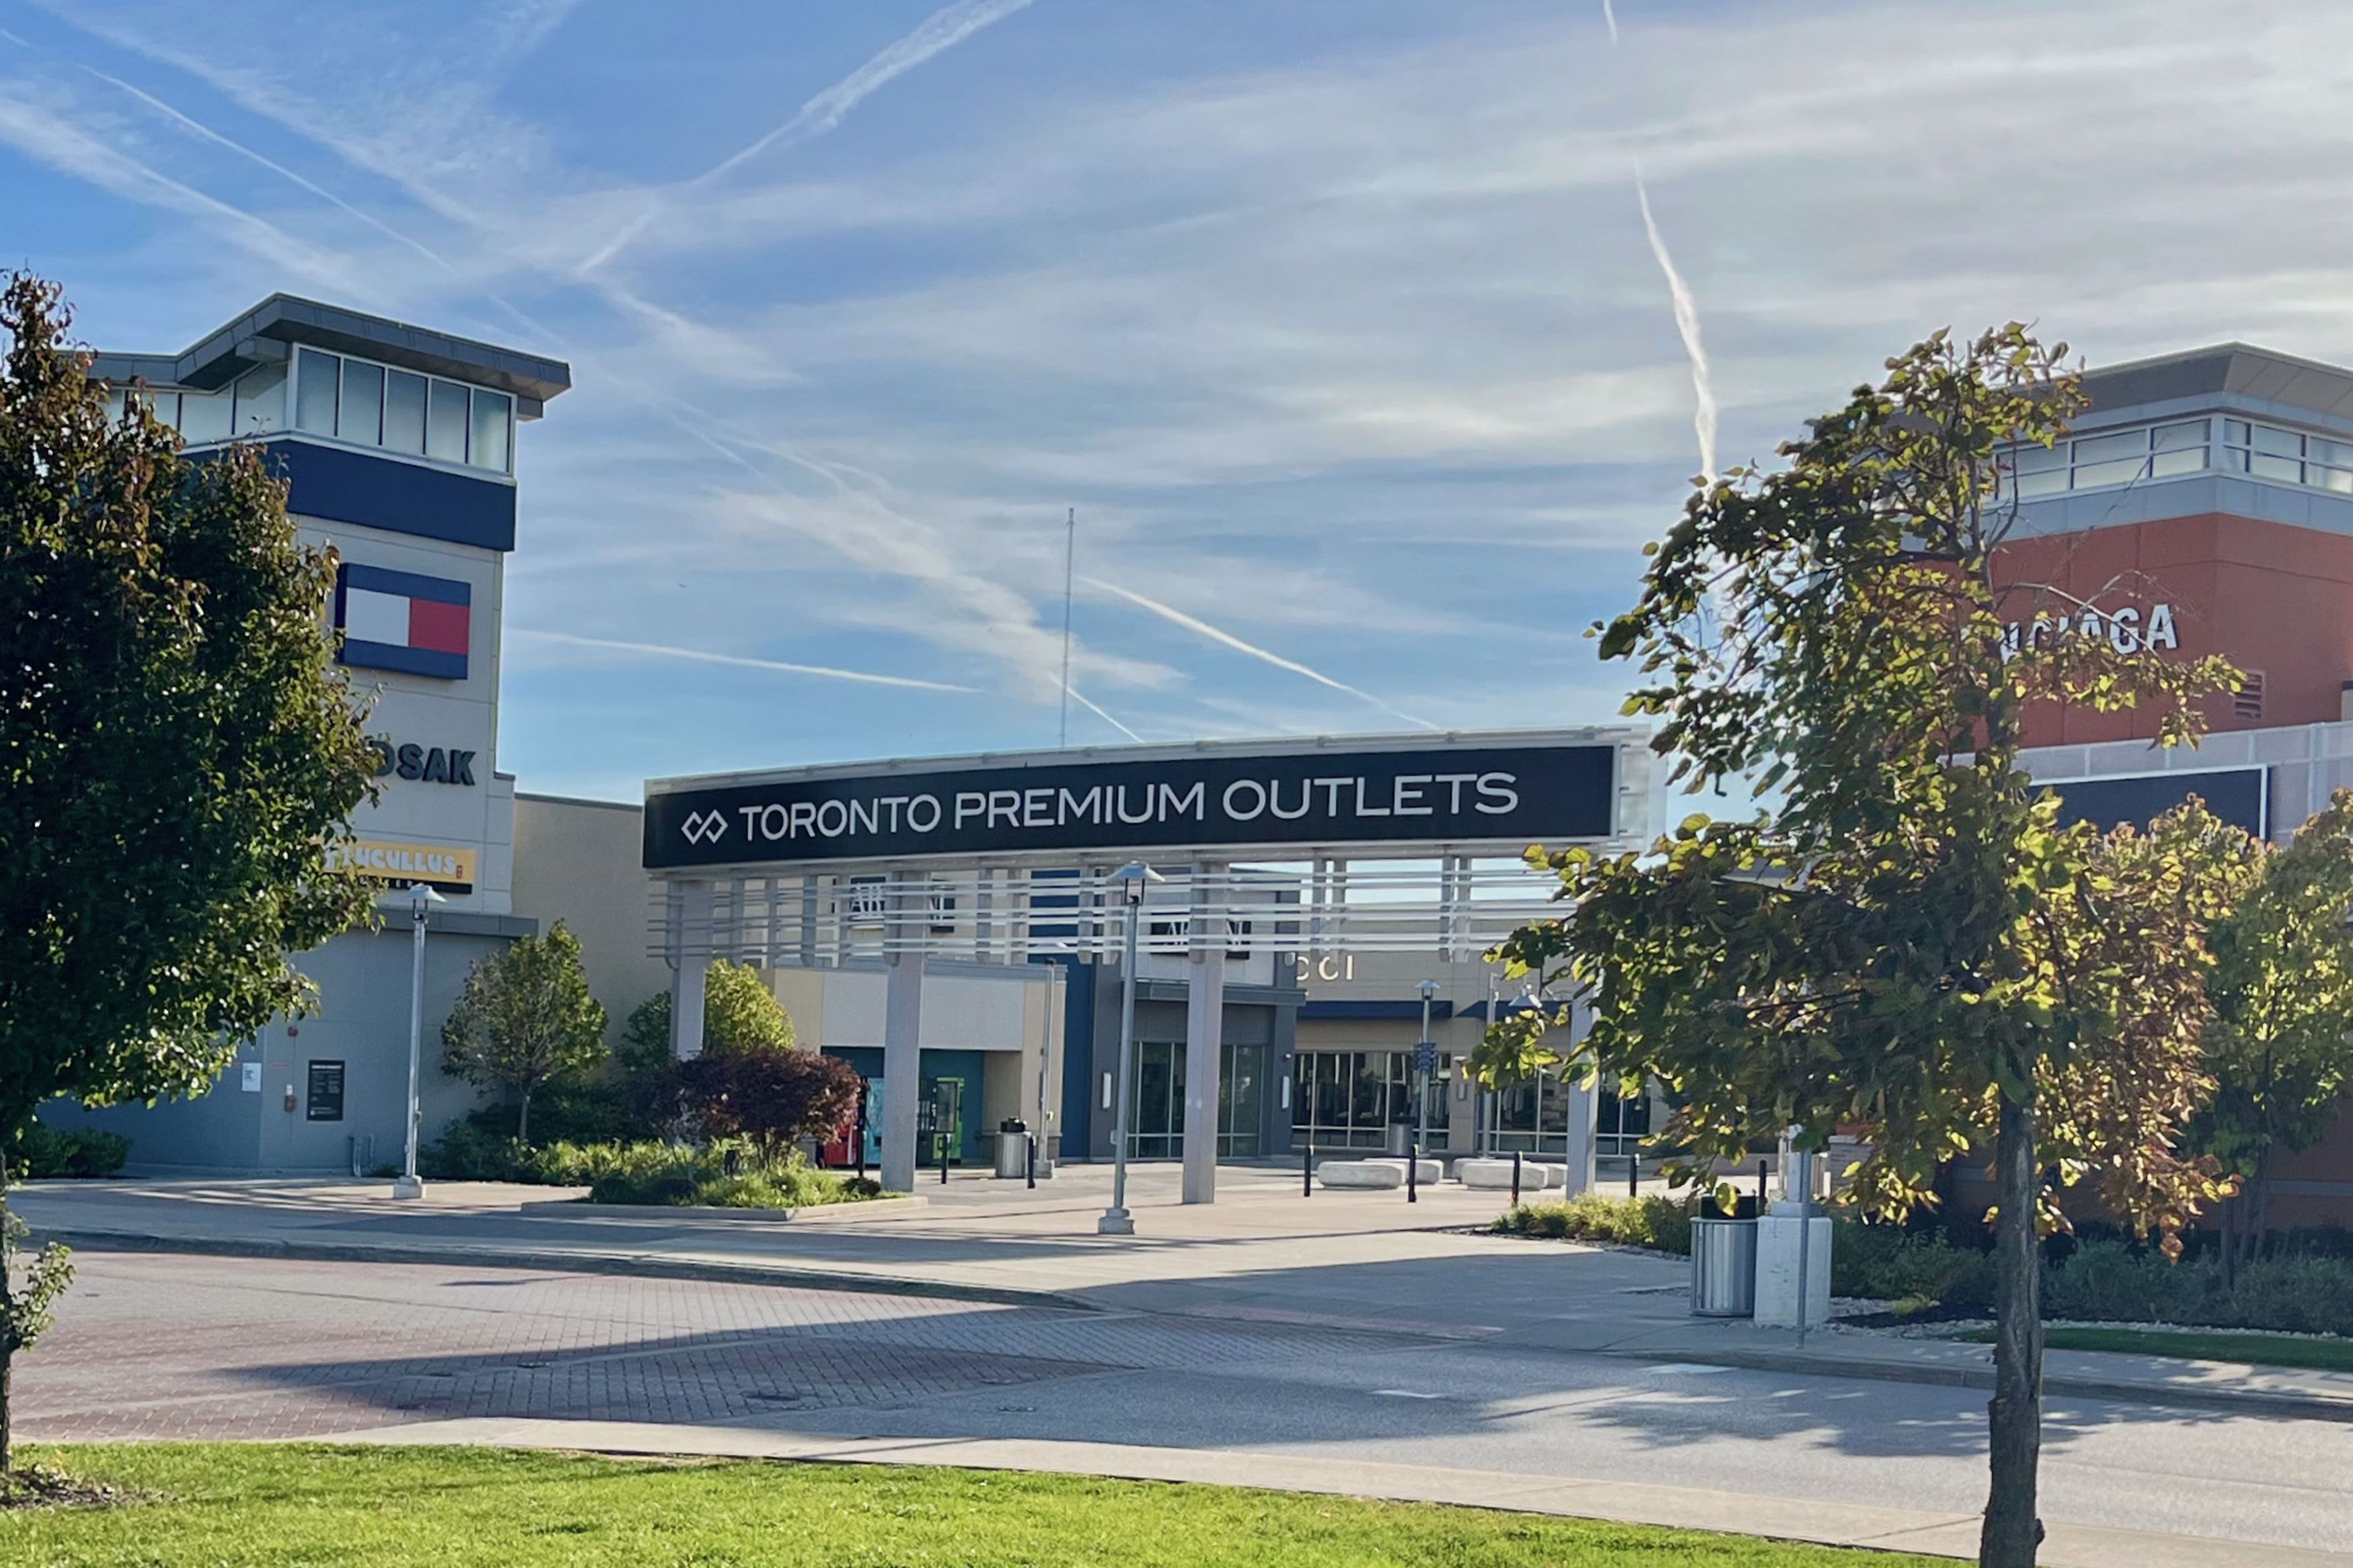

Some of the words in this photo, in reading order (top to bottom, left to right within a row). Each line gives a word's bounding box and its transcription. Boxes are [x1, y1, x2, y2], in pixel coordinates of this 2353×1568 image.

[738, 794, 941, 842] TORONTO
[955, 782, 1205, 829] PREMIUM
[1222, 772, 1519, 820] OUTLETS
